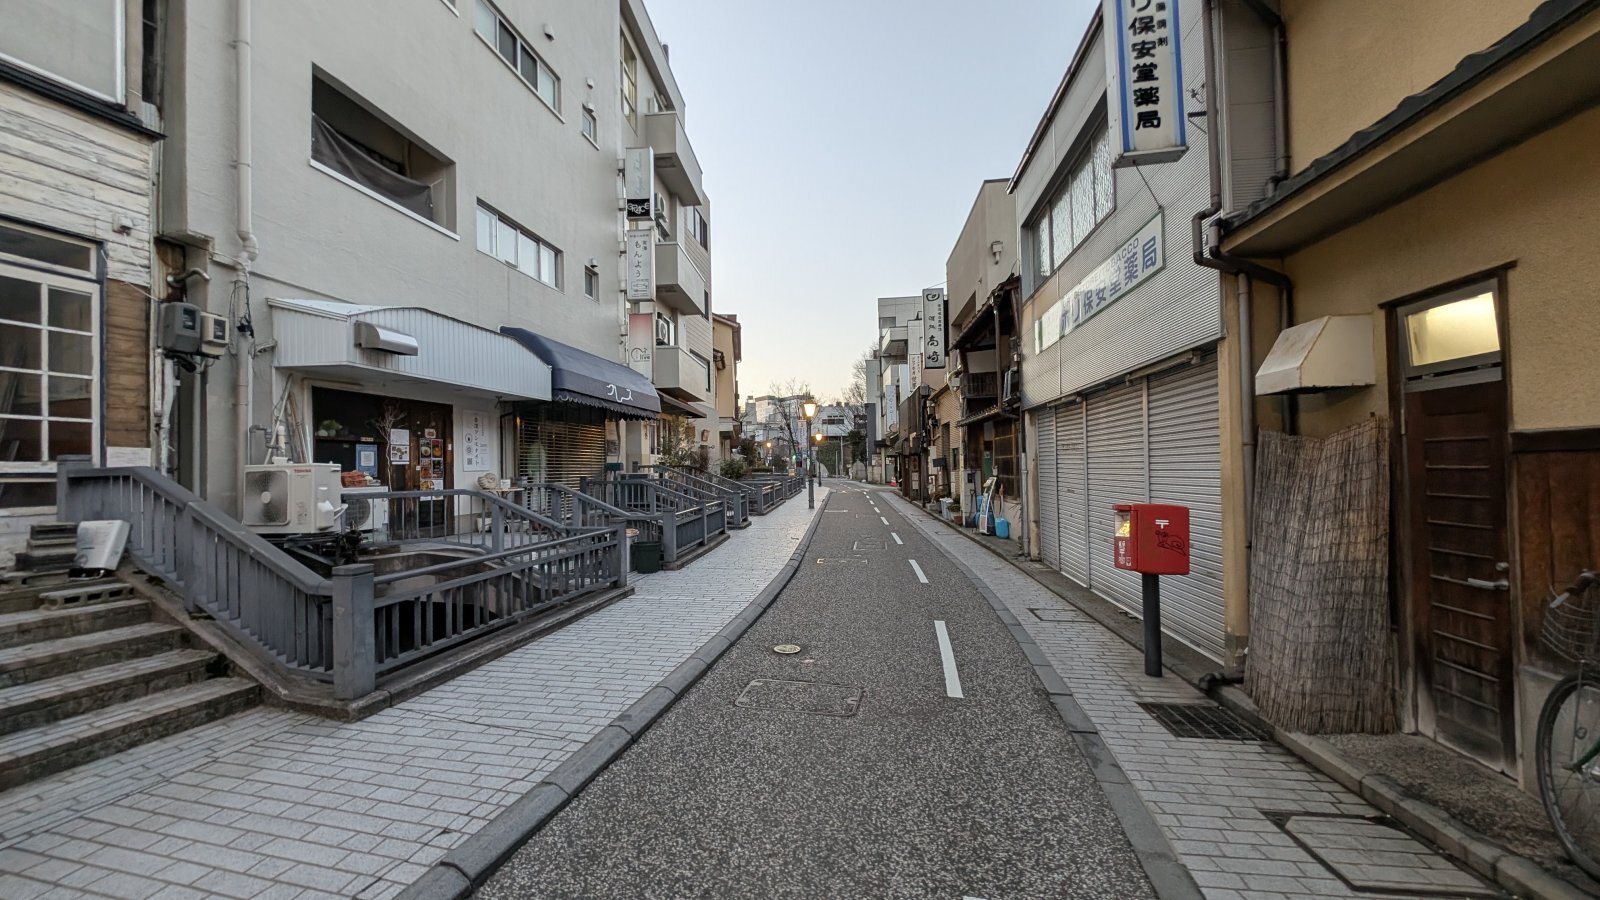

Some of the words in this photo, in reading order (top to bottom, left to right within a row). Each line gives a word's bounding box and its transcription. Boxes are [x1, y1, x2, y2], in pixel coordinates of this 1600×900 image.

[627, 203, 651, 214] GRACE
[634, 241, 643, 278] もんよう
